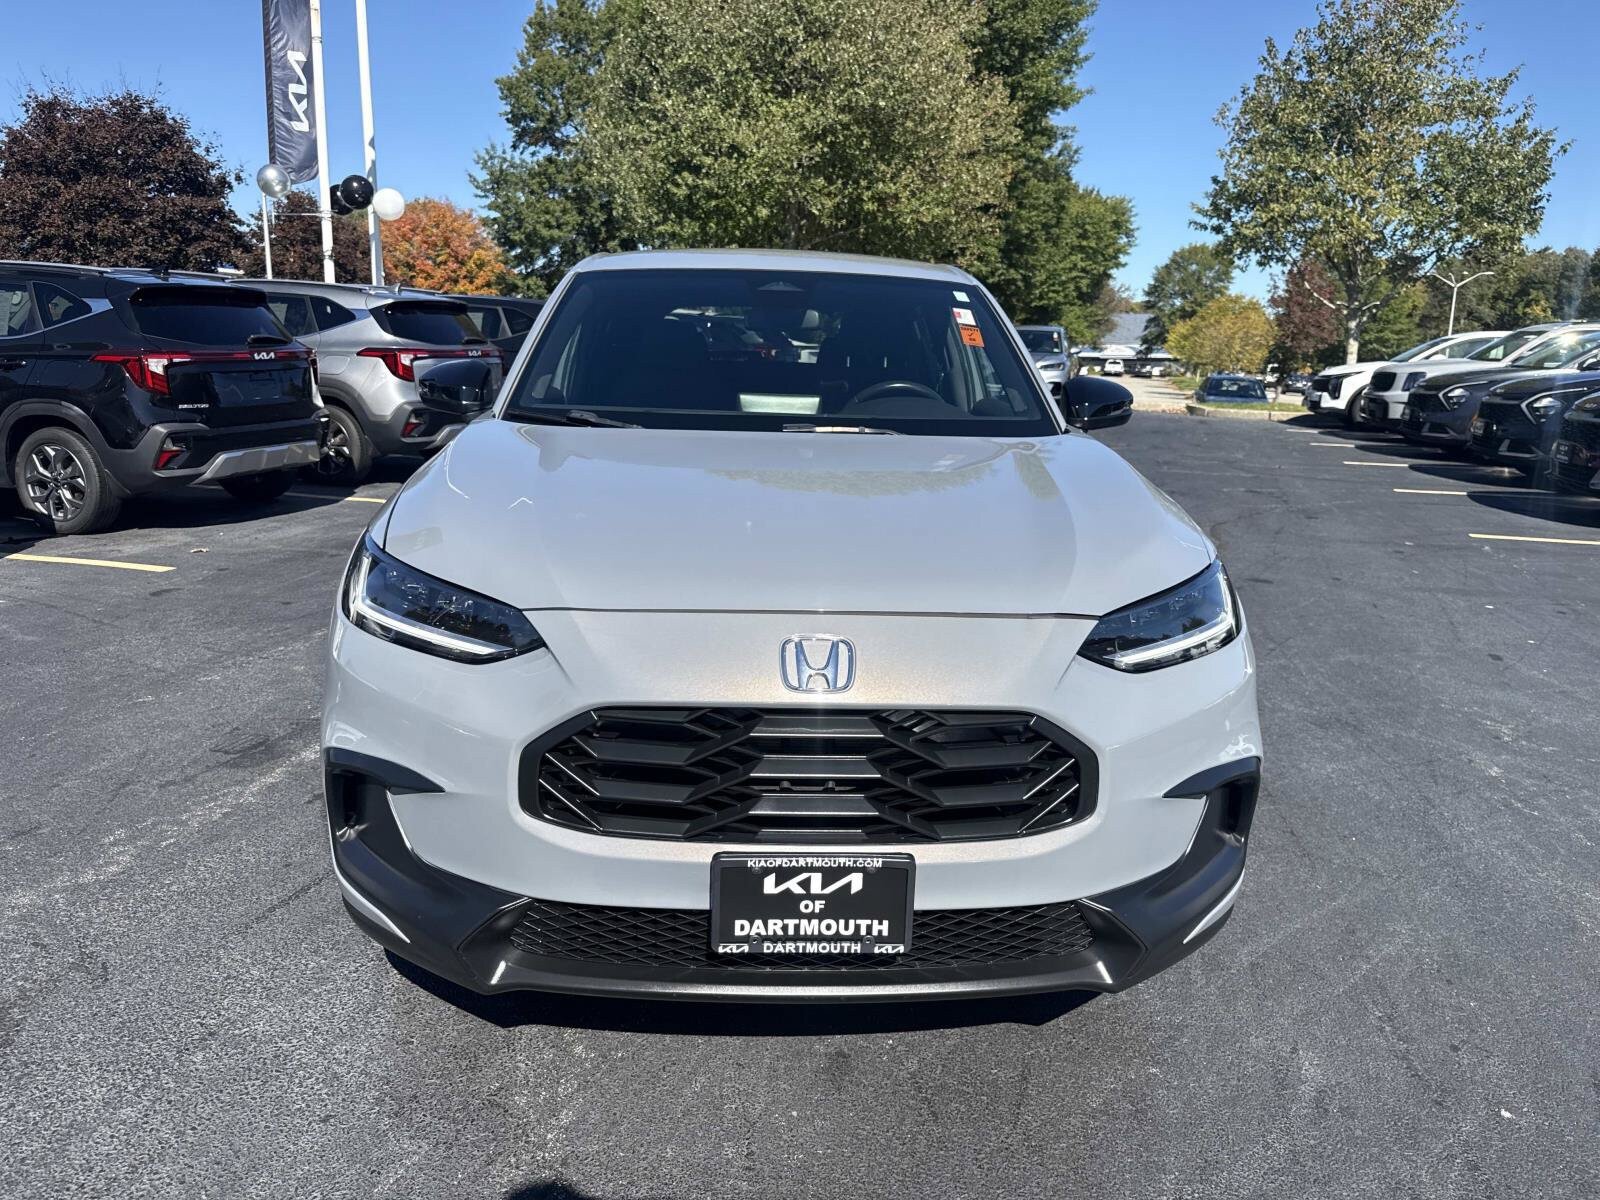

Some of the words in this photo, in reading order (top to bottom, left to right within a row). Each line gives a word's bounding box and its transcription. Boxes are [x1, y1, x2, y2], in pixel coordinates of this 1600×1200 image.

[287, 50, 309, 132] KIA
[253, 352, 275, 360] KIA
[747, 858, 883, 868] KIAOFDARTMOUTH.COM
[763, 872, 863, 895] KIA
[799, 900, 826, 914] OF
[734, 919, 889, 937] DARTMOUTH
[763, 941, 861, 954] DARTMOUTH
